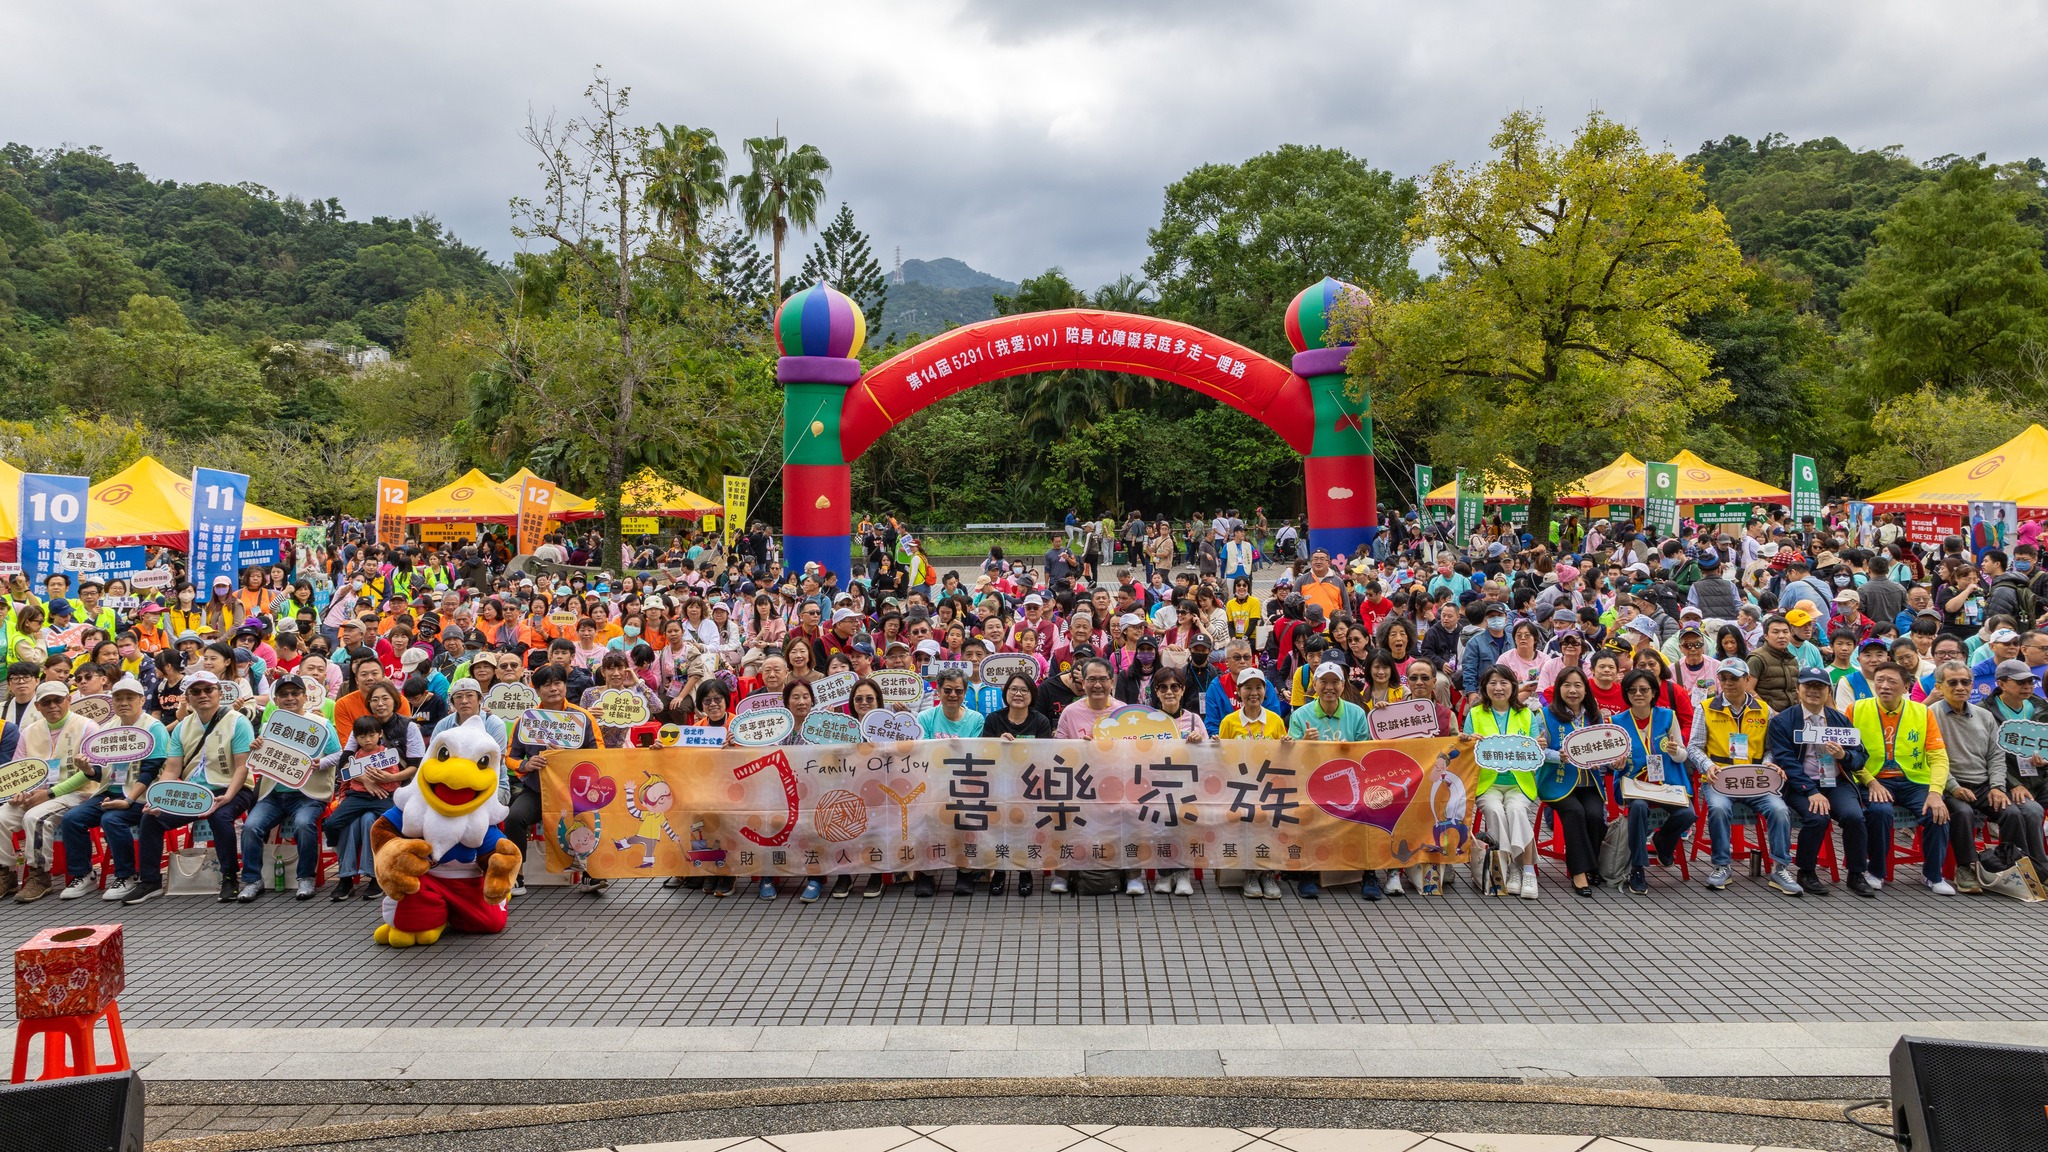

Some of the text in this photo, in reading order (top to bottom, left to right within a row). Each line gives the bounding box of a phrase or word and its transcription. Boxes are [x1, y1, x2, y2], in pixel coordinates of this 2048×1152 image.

[1422, 473, 1429, 487] 5
[1656, 472, 1670, 488] 6
[1802, 465, 1814, 482] 6
[205, 485, 234, 511] 11
[384, 488, 404, 504] 12
[528, 487, 549, 505] 12
[30, 493, 79, 523] 10
[1932, 516, 1937, 526] 4
[252, 540, 259, 549] 11
[105, 551, 116, 561] 10
[816, 678, 844, 694] 台北市
[881, 677, 907, 687] 台北市
[503, 692, 522, 701] 台北
[614, 697, 630, 705] 台北
[814, 684, 854, 703] 萊扶輪社
[751, 697, 778, 708] 台北市
[821, 720, 848, 733] 台北市
[883, 719, 903, 731] 台北
[1376, 715, 1434, 732] 忠誠扶輪社
[269, 721, 319, 748] 信創集團
[806, 725, 858, 743] 西北區扶輪社
[1824, 728, 1851, 736] 台北市
[91, 742, 147, 753] 股份有限公司
[1570, 737, 1626, 757] 東鴻扶輪社
[364, 757, 397, 769] 利商店
[370, 752, 386, 763] 全家
[1482, 750, 1538, 762] 華朋扶輪社
[0, 764, 36, 784] 科技工坊
[252, 753, 304, 780] 股份有限公司
[804, 756, 929, 778] Family Of Joy
[1365, 775, 1386, 784] Family
[942, 752, 1300, 831] 喜樂家族
[153, 796, 203, 810] 股份有限公司
[740, 842, 1302, 866] 財團法人台北市喜樂家族社會福利基金會
